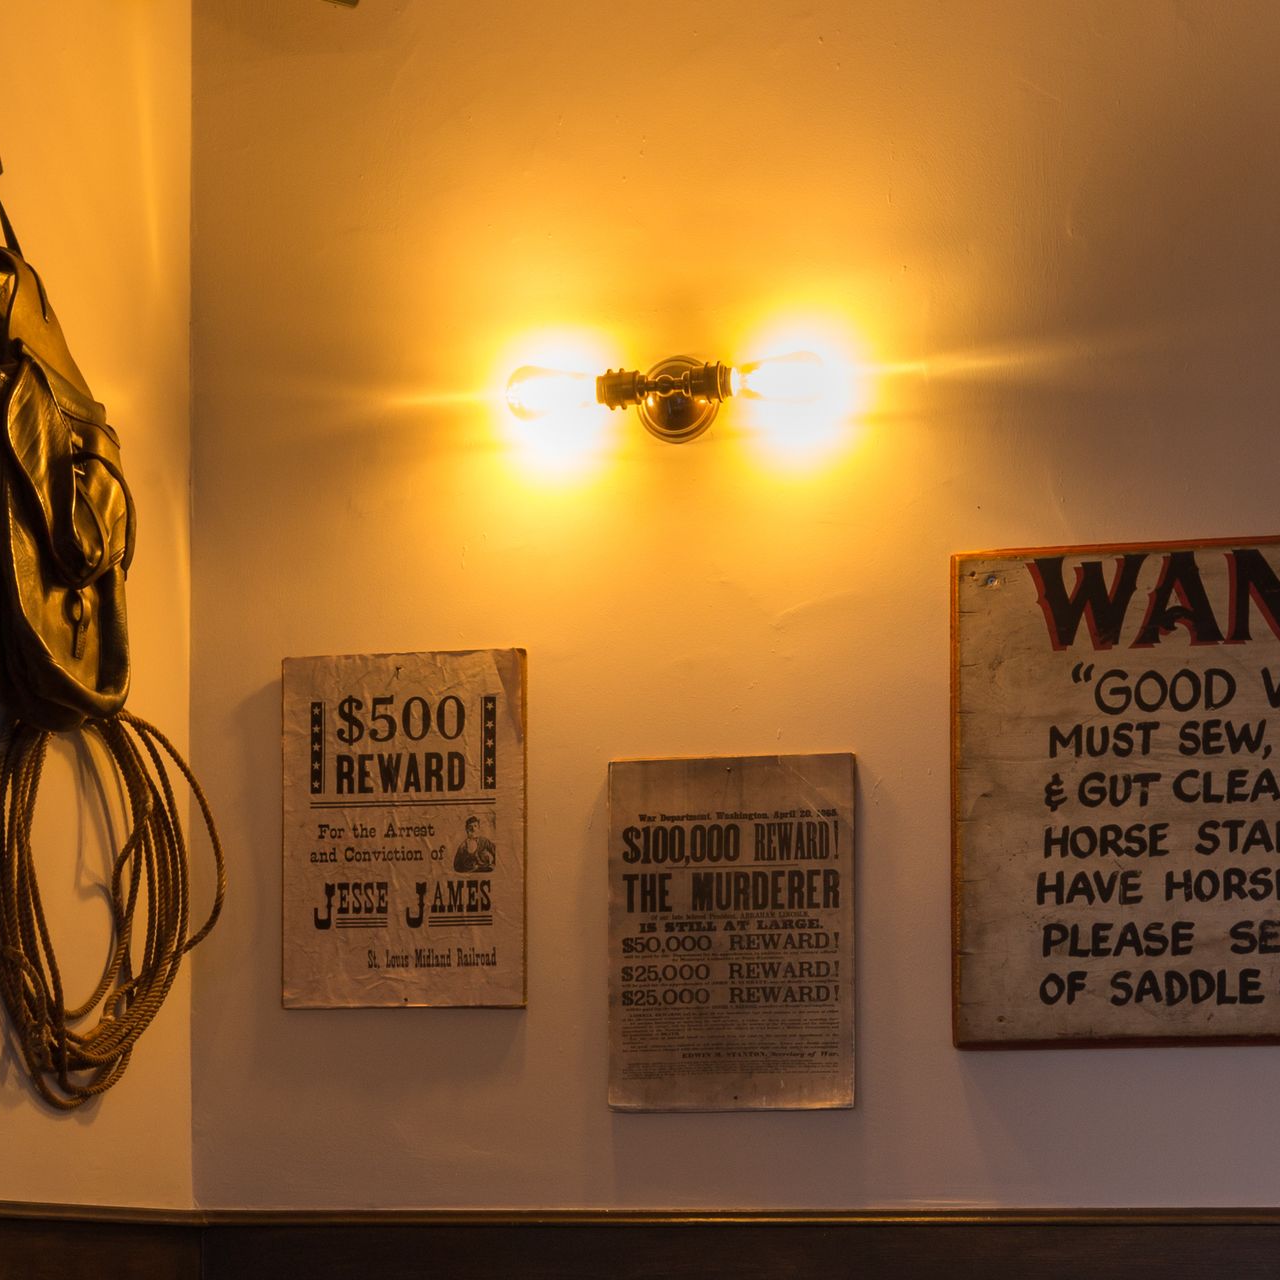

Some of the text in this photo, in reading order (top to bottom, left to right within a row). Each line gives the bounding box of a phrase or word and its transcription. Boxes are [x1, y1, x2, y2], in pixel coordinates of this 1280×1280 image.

[1071, 662, 1236, 715] "GOOD
[336, 695, 465, 745] $500
[1049, 719, 1159, 757] MUST
[1178, 718, 1272, 760] SEW,
[336, 751, 466, 794] REWARD
[1045, 773, 1067, 811] &
[1078, 773, 1161, 807] GUT
[318, 823, 435, 839] For the Arrest
[639, 814, 656, 822] War
[773, 810, 795, 819] April
[310, 845, 446, 863] and Conviction of
[622, 823, 740, 867] $100,000
[1043, 822, 1169, 858] HORSE
[314, 880, 491, 930] JESSE JAMES
[623, 869, 840, 913] THE MURDERER
[1036, 870, 1142, 905] HAVE
[640, 918, 823, 933] IS STILL AT LARGE.
[729, 932, 840, 950] REWARD!
[1043, 921, 1194, 956] PLEASE
[368, 947, 497, 968] St. Louis Midland Railroad
[621, 964, 710, 983] $25,000
[729, 960, 840, 980] REWARD!
[729, 985, 840, 1003] REWARD!
[1040, 970, 1088, 1005] OF
[1111, 968, 1264, 1005] SADDLE
